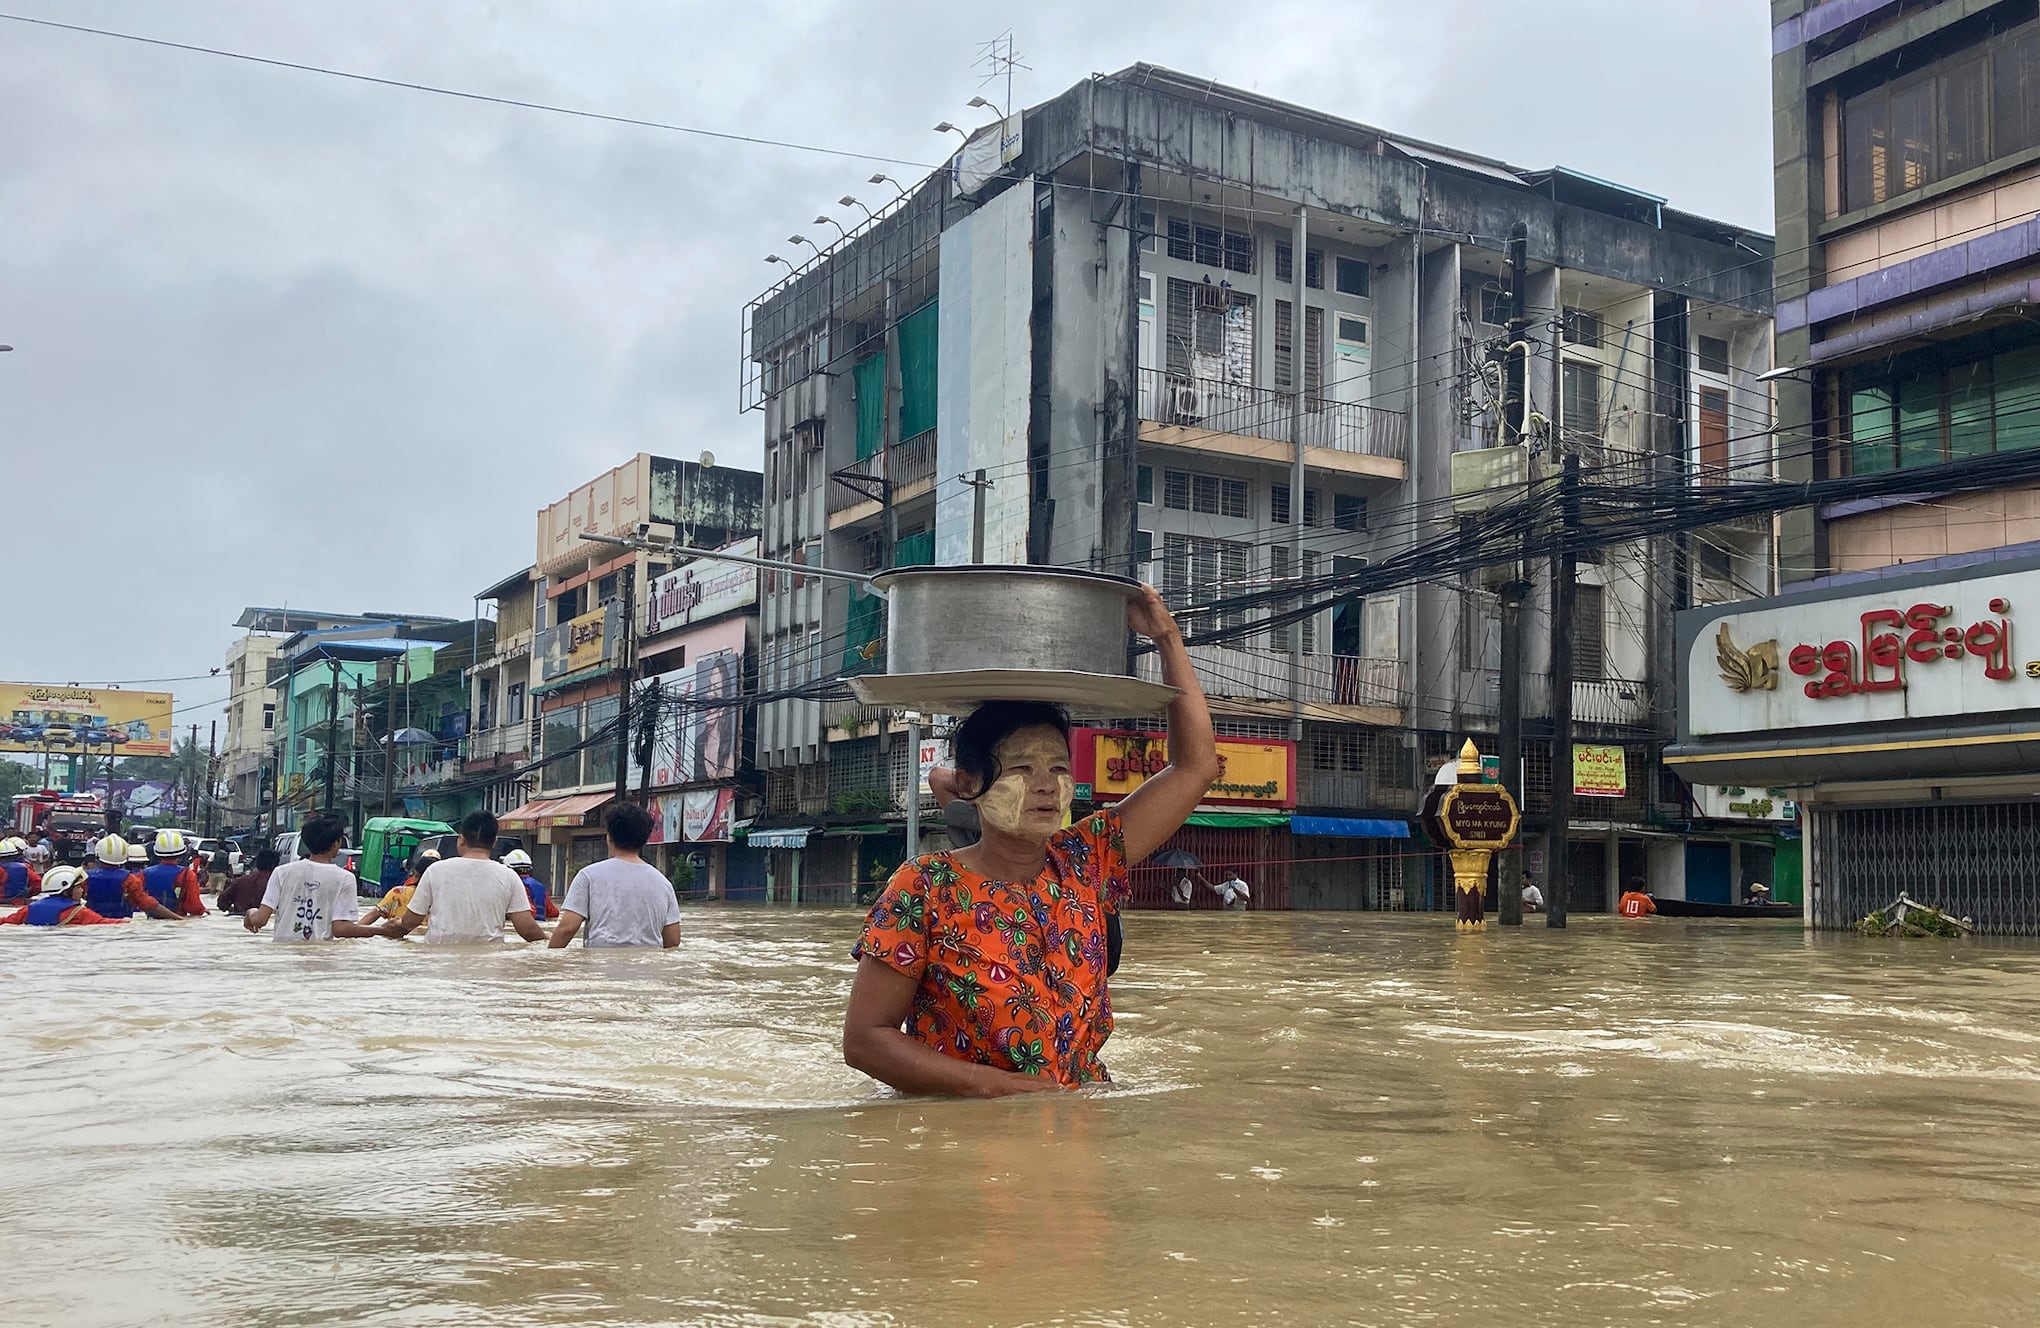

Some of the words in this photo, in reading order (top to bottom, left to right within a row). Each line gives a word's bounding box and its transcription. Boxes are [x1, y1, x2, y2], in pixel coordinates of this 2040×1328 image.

[921, 747, 936, 763] KT
[1455, 819, 1470, 827] MYO
[1471, 819, 1483, 827] MA
[1626, 899, 1639, 914] 10
